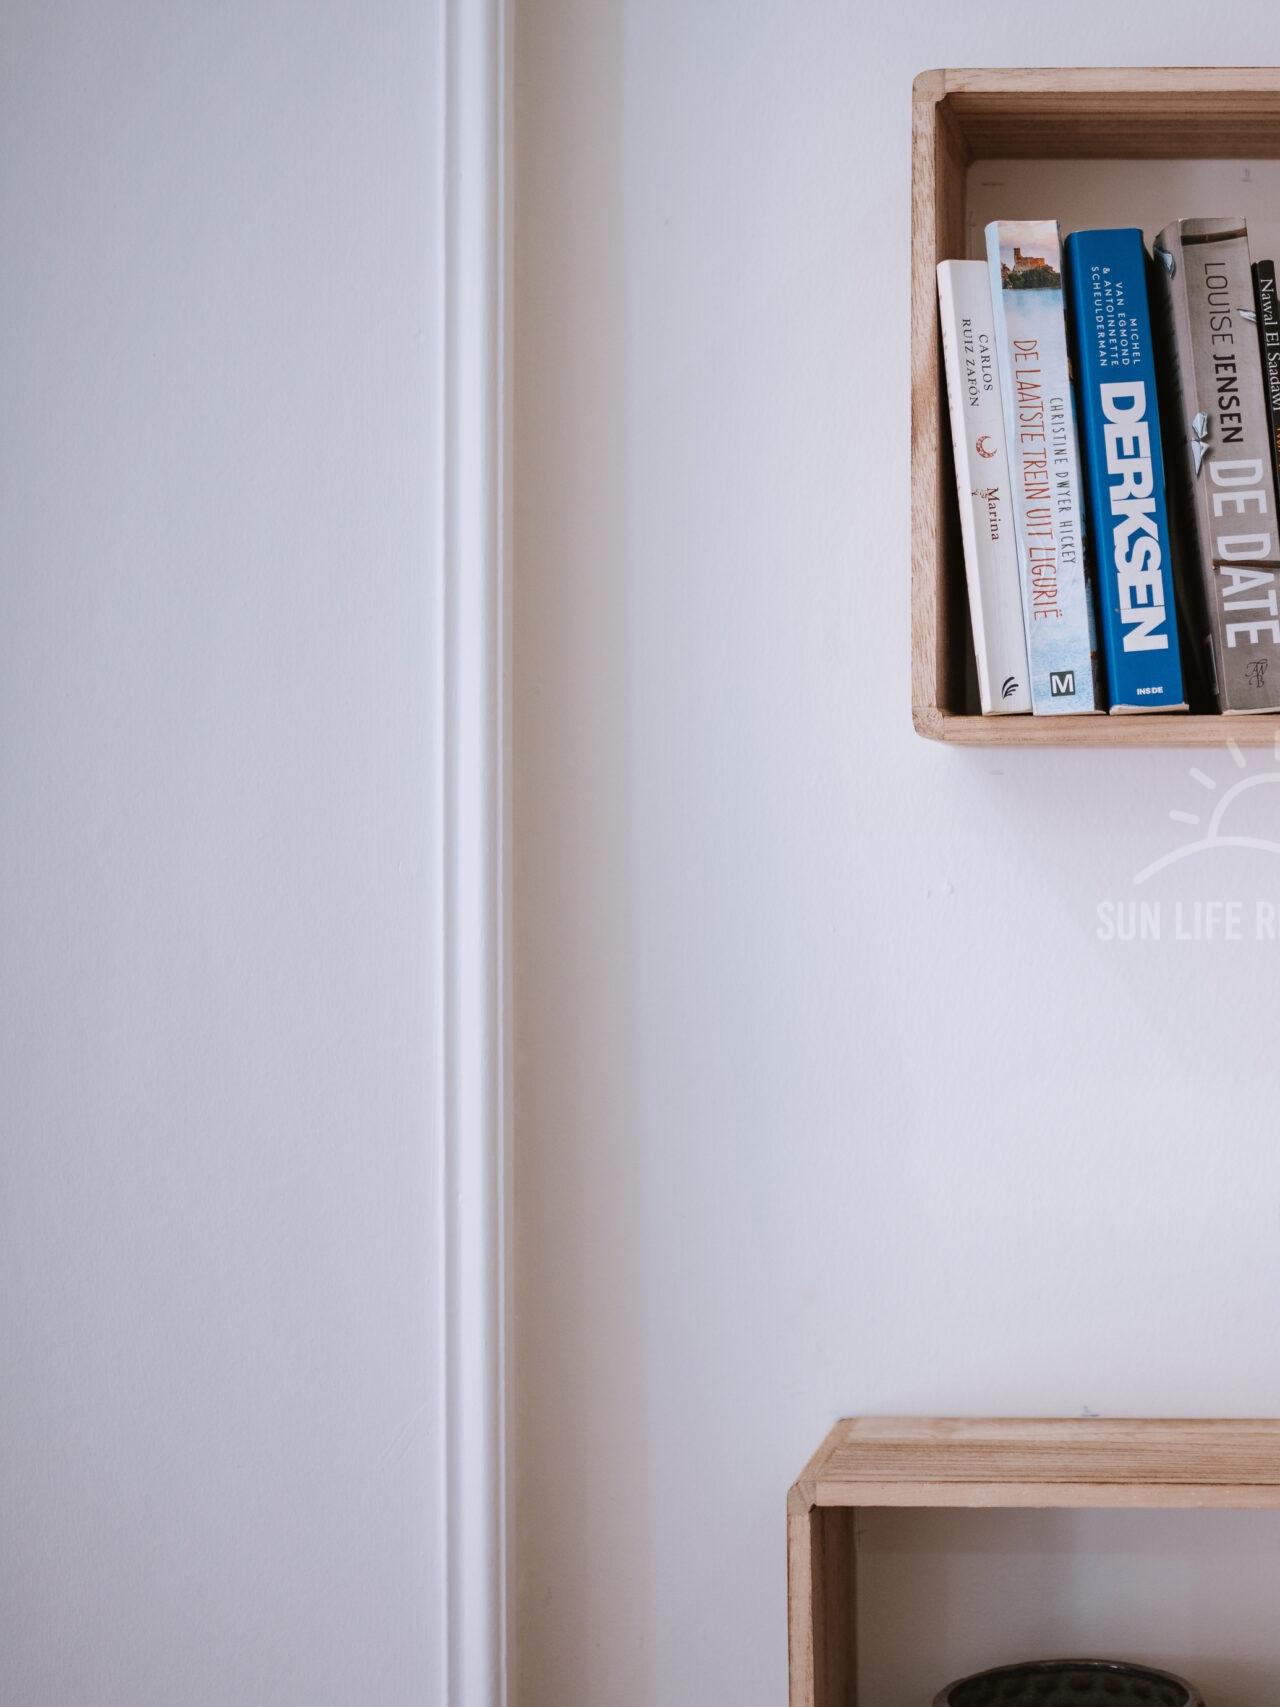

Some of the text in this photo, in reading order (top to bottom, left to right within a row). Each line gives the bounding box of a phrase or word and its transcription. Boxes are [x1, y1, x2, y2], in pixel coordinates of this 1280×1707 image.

[1091, 266, 1107, 367] SCHEULDERMAN
[1104, 280, 1119, 366] ANTOINNETTE
[1115, 282, 1130, 366] VAN EGMOND
[1129, 318, 1141, 365] MICHEL
[1260, 278, 1278, 327] Nawal
[1264, 332, 1280, 346] El
[962, 319, 979, 407] RUIZ ZAFÓN
[978, 334, 993, 391] CARLOS
[1013, 340, 1062, 621] DE LAATSTE TREIN UIT LIGURIË
[1049, 397, 1076, 565] CHRISTINE DWYER HICKEY
[1204, 262, 1280, 649] LOUISE JENSEN DE DATE
[986, 487, 1000, 541] Marina
[1100, 381, 1169, 653] DERKSEN
[1051, 674, 1075, 694] M
[1136, 686, 1164, 696] INSIDE
